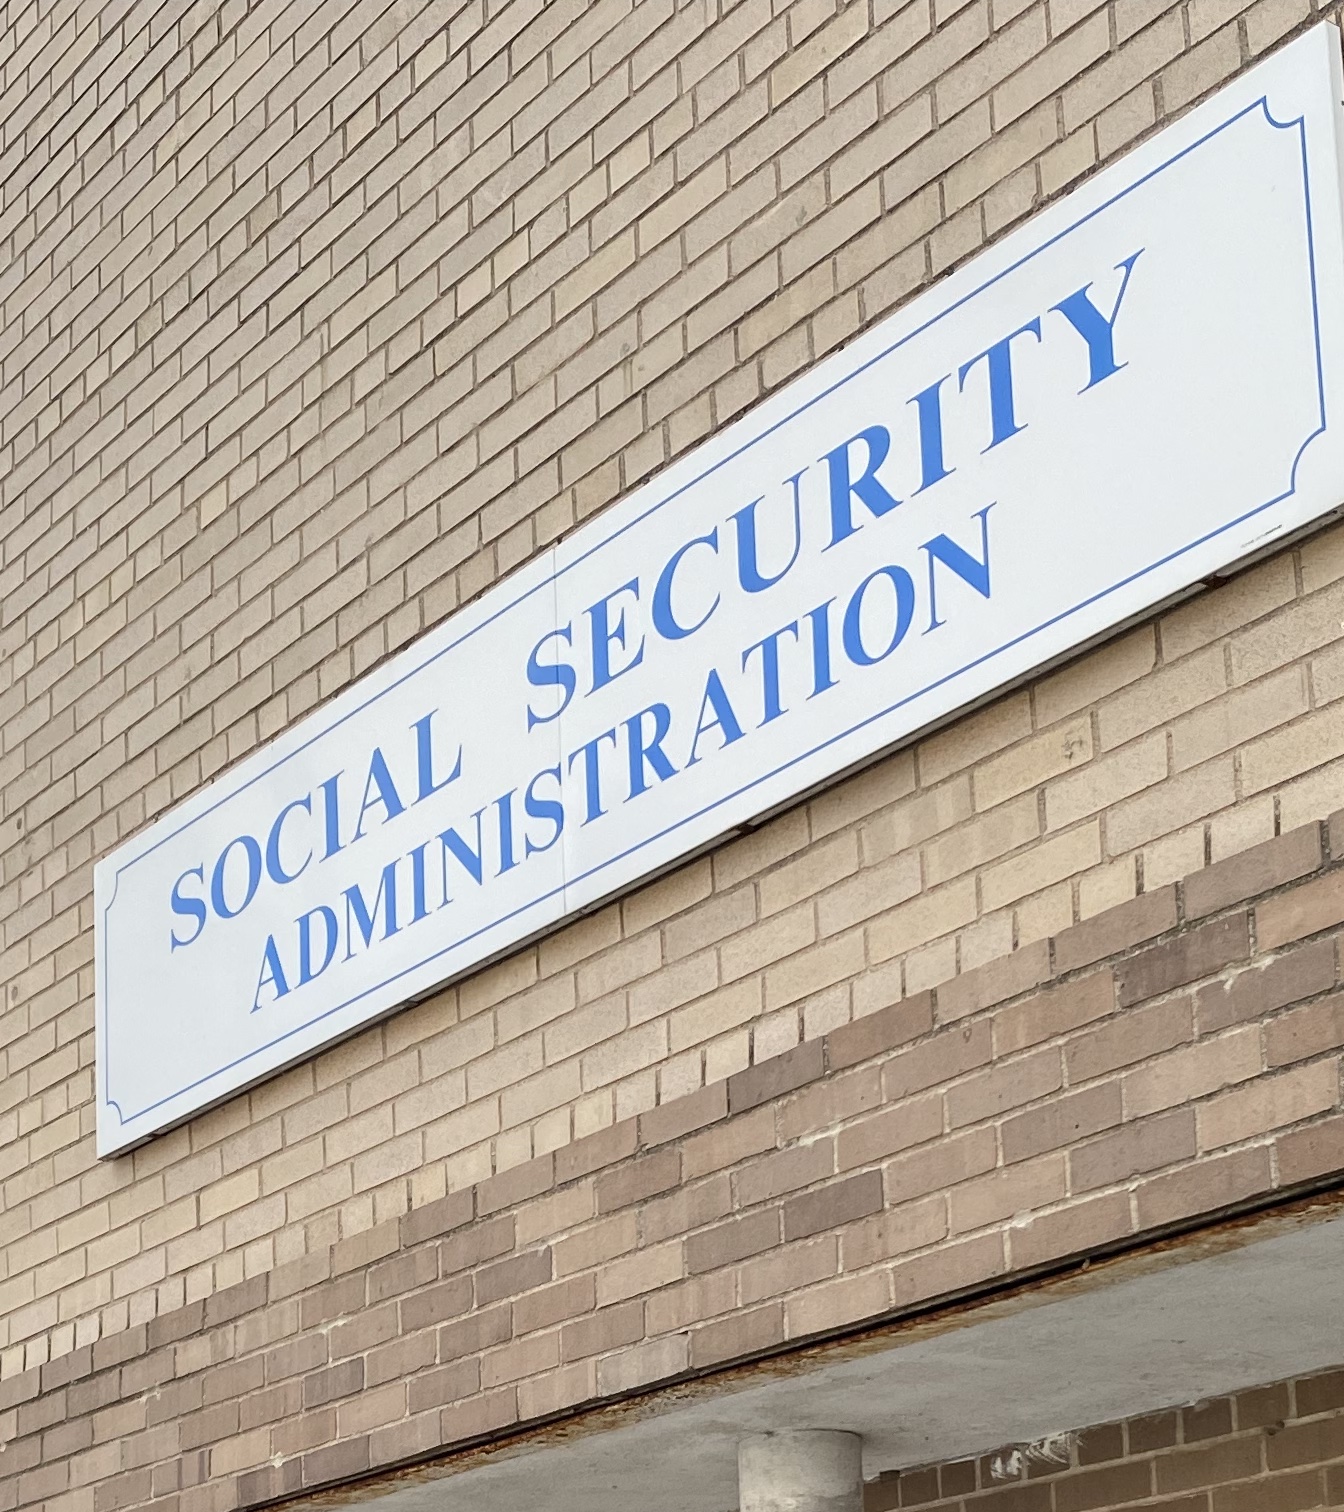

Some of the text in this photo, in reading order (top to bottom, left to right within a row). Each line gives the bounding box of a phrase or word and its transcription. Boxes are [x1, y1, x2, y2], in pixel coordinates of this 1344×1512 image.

[170, 249, 1145, 951] SOCIAL SECURITY
[250, 502, 997, 1013] ADMINISTRATION
